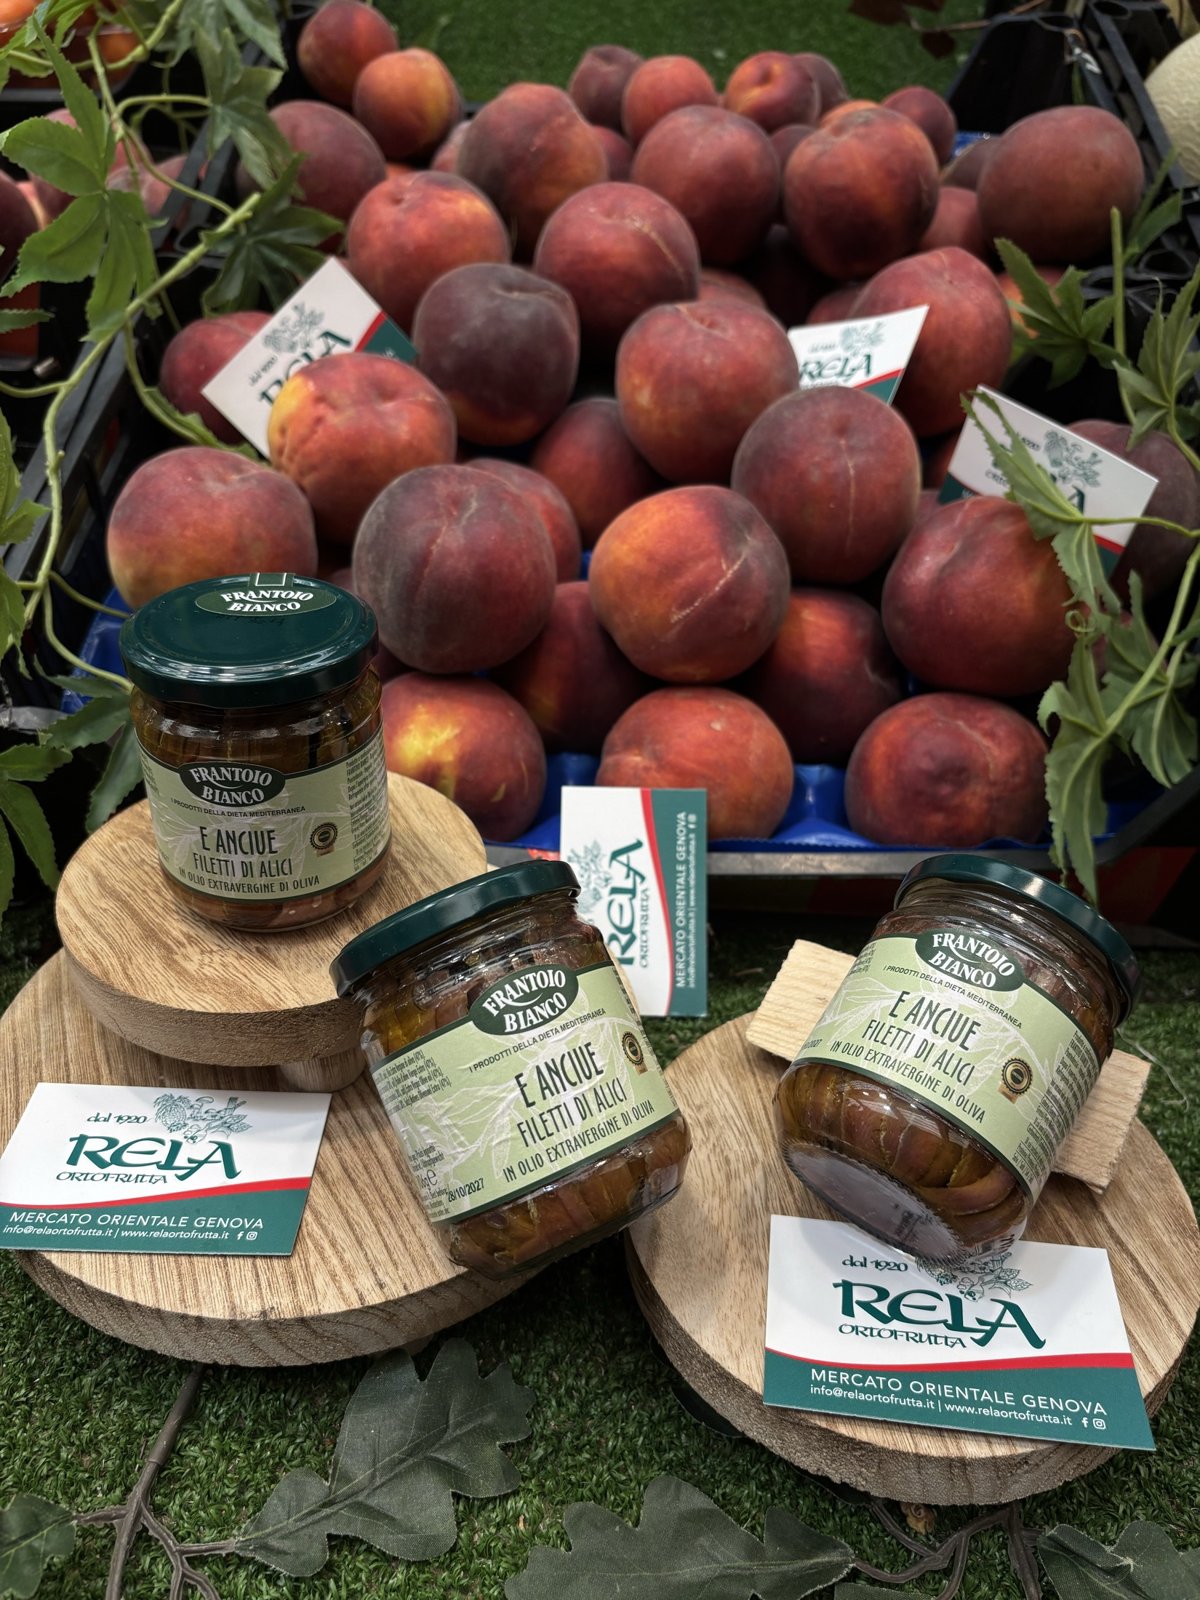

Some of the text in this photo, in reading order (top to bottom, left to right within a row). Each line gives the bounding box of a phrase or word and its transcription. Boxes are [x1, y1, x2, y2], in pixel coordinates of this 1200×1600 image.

[221, 590, 313, 602] FRANTOIO
[227, 602, 301, 612] BIANCO
[189, 767, 272, 788] FRANTOIO
[201, 786, 264, 804] BIANCO
[174, 799, 203, 812] PRODOTTI
[204, 808, 226, 817] DELLA
[249, 806, 306, 817] MEDITERRANEA
[200, 826, 278, 855] E ANCIUE
[179, 867, 320, 894] IN OLIO EXTRAVERGINE DI OLIVA
[193, 852, 236, 877] FILETTI
[242, 861, 254, 878] DI
[260, 858, 293, 878] ALICI
[607, 838, 646, 967] RELA
[675, 811, 687, 988] MERCATO ORIENTALE GENOVA
[928, 950, 996, 988] BIANCO
[932, 933, 1015, 976] FRANTOIO
[482, 969, 566, 1017] FRANTOIO
[503, 992, 568, 1033] BIANCO
[886, 965, 919, 978] PRODOTTI
[919, 972, 943, 985] DELLA
[944, 982, 966, 995] DIETA
[966, 992, 1022, 1029] MEDITERRANEA
[474, 1048, 512, 1070] PRODOTTI
[512, 1037, 539, 1053] DELLA
[538, 1025, 560, 1041] DIETA
[560, 1007, 607, 1031] MEDITERRANEA
[888, 990, 981, 1051] E ANCIUE
[862, 1019, 975, 1086] FILETTI DI ALICI
[514, 1072, 536, 1108] E
[535, 1042, 604, 1101] ANCIUE
[830, 1040, 842, 1053] IN
[843, 1042, 865, 1058] OLIO
[864, 1049, 942, 1094] EXTRAVERGINE
[941, 1085, 955, 1102] DI
[955, 1094, 986, 1124] OLIVA
[87, 1112, 148, 1125] dal 1920
[516, 1077, 628, 1148] FILETTI DI ALICI
[66, 1133, 243, 1181] RELA
[503, 1099, 655, 1183] IN OLIO EXTRAVERGINE DI OLIVA
[56, 1171, 168, 1184] ORTOFRUTTA
[2, 1225, 113, 1238] info@relaortofrutta.it
[120, 1229, 229, 1240] www.relaortofrutta.it
[9, 1211, 264, 1229] MERCATO ORIENTALE GENOVA
[842, 1255, 908, 1272] dal 1920
[832, 1279, 1046, 1350] RELA
[838, 1323, 967, 1349] ORTOFRUTTA
[810, 1384, 935, 1410] info@relaortofrutta.it
[944, 1401, 1073, 1426] www.relaortofrutta.it
[811, 1368, 1107, 1416] MERCATO ORIENTALE GENOVA
